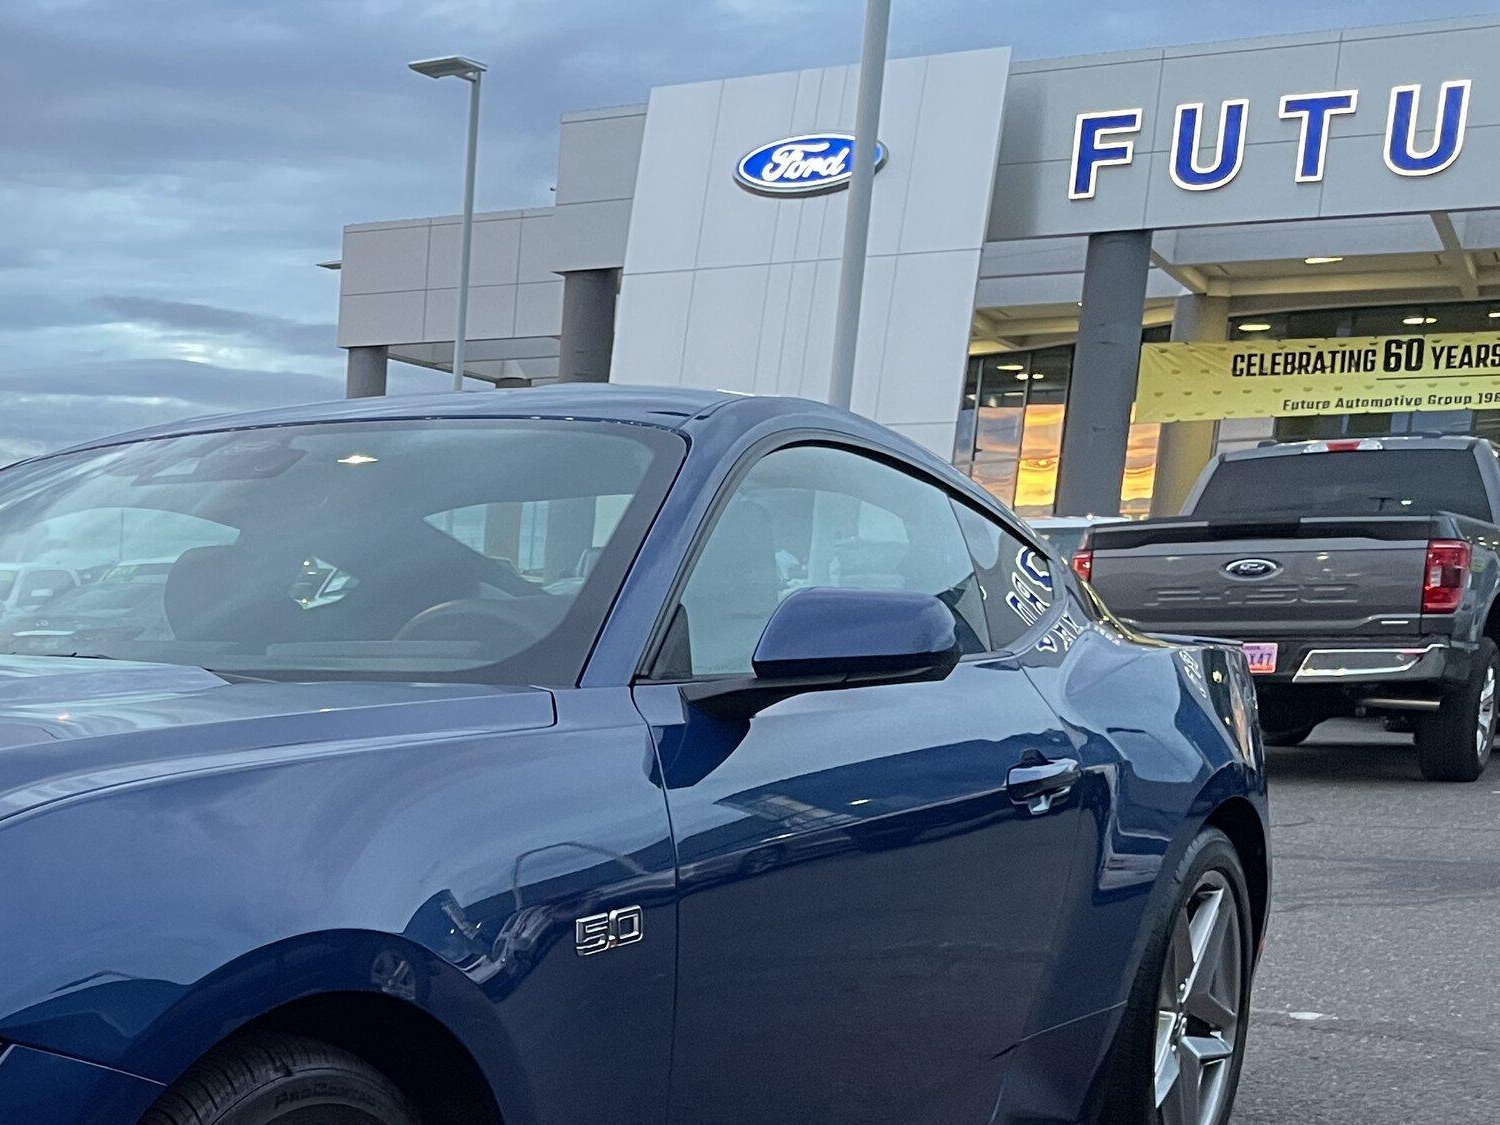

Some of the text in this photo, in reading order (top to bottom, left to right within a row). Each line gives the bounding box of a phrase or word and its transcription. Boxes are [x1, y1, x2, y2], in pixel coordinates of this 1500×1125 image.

[1068, 79, 1472, 200] FUTU
[761, 142, 850, 182] Ford
[1231, 338, 1500, 377] CELEBRATING 60 YEARS
[1282, 399, 1330, 411] Future
[1335, 395, 1422, 409] Automotive
[1428, 394, 1472, 405] Group
[575, 905, 644, 957] 5.0
